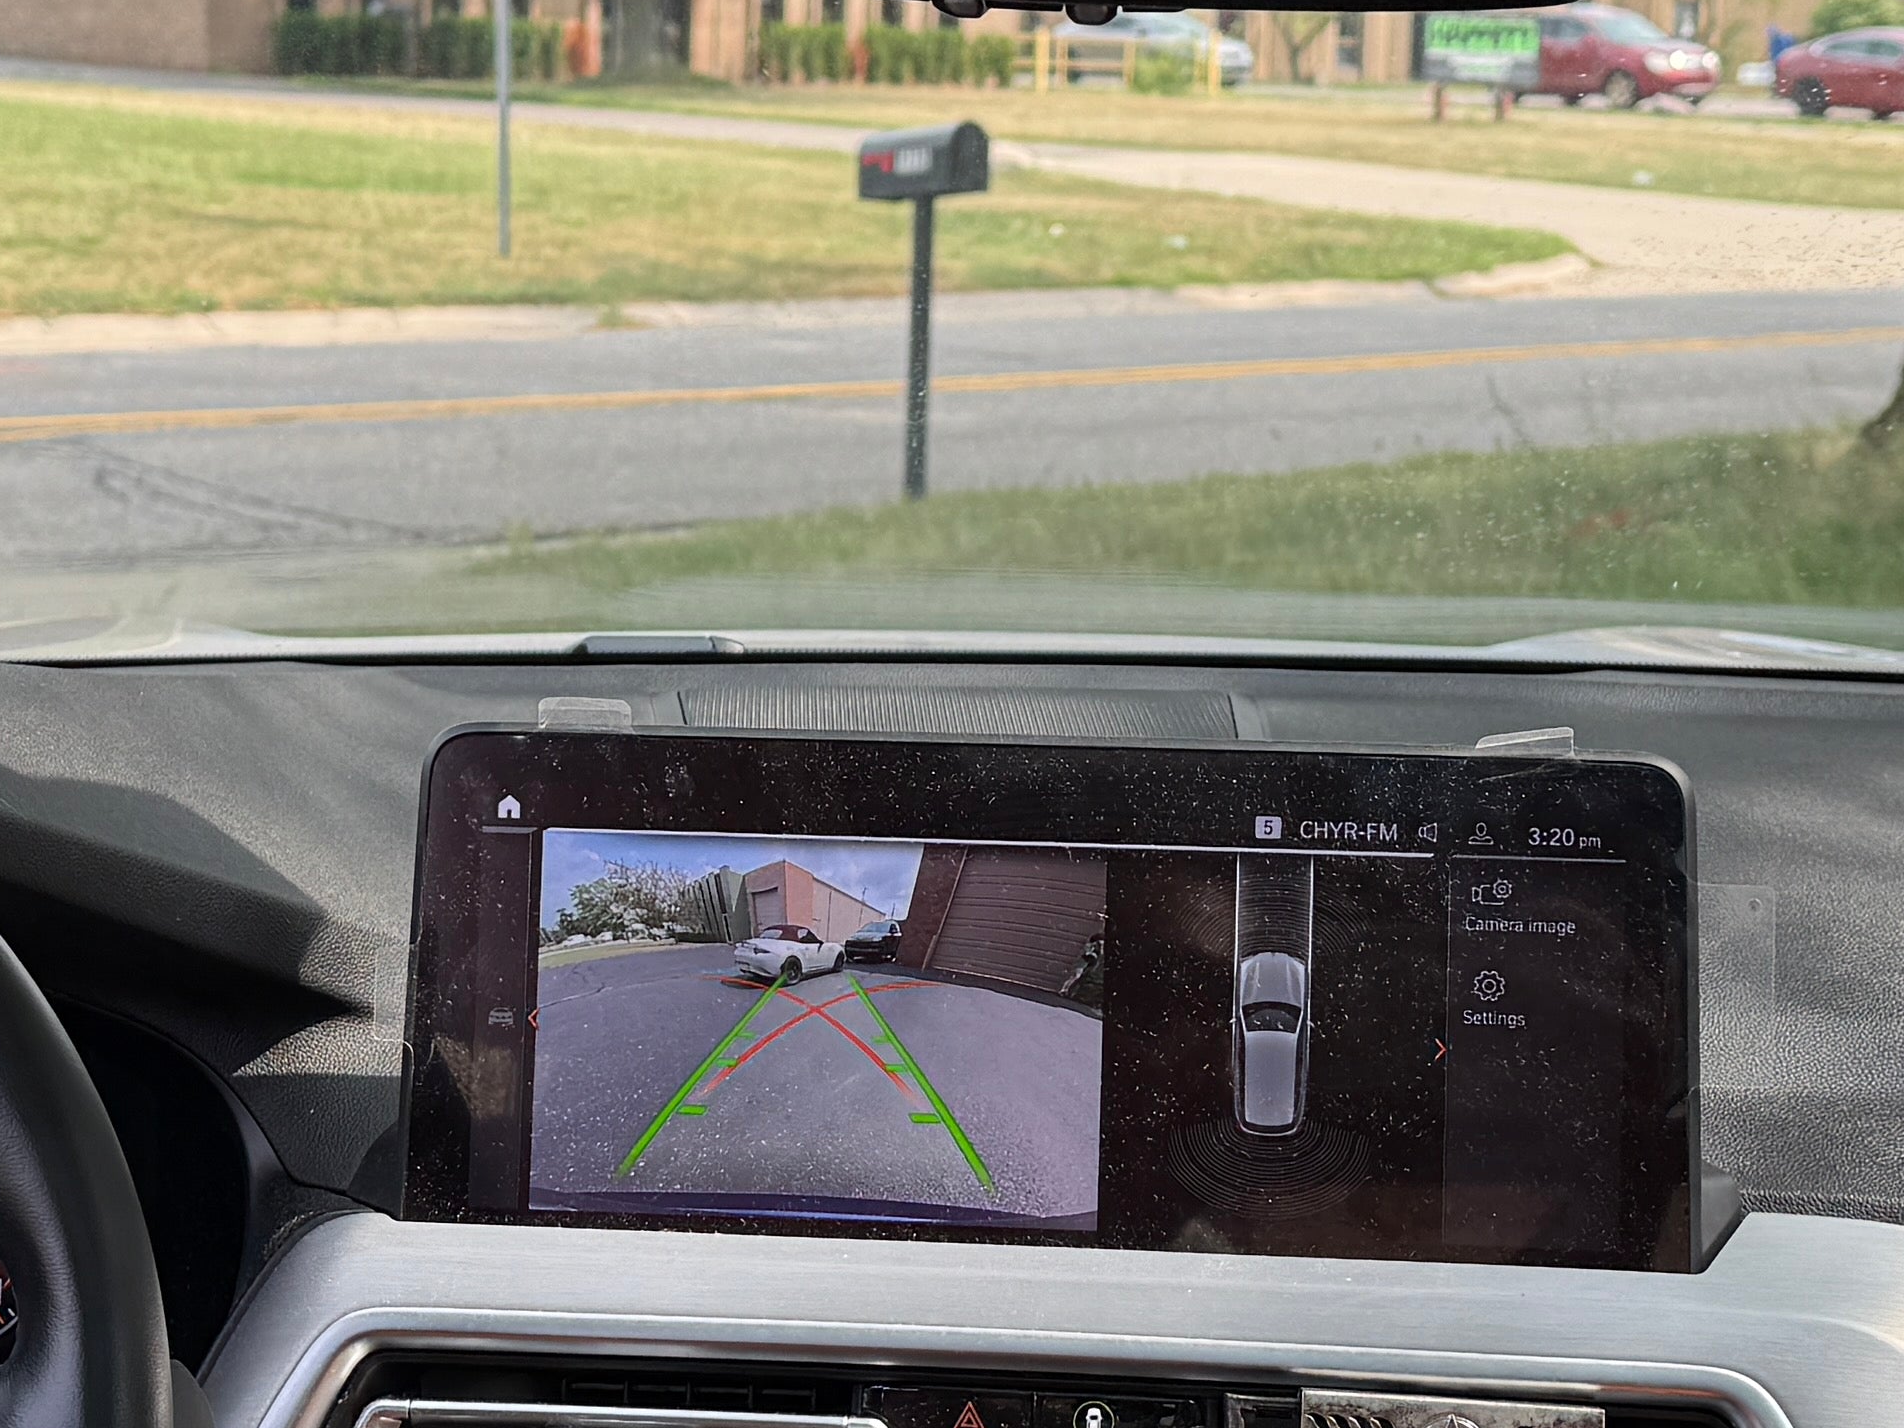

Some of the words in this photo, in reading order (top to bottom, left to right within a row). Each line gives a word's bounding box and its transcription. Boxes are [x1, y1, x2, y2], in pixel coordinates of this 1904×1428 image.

[1263, 819, 1275, 837] 5
[1299, 820, 1398, 843] CHYR-FM
[1527, 826, 1576, 848] 3:20
[1579, 834, 1602, 851] pm
[1464, 915, 1525, 935] Camera
[1527, 916, 1577, 937] image
[1462, 1009, 1527, 1030] Settings
